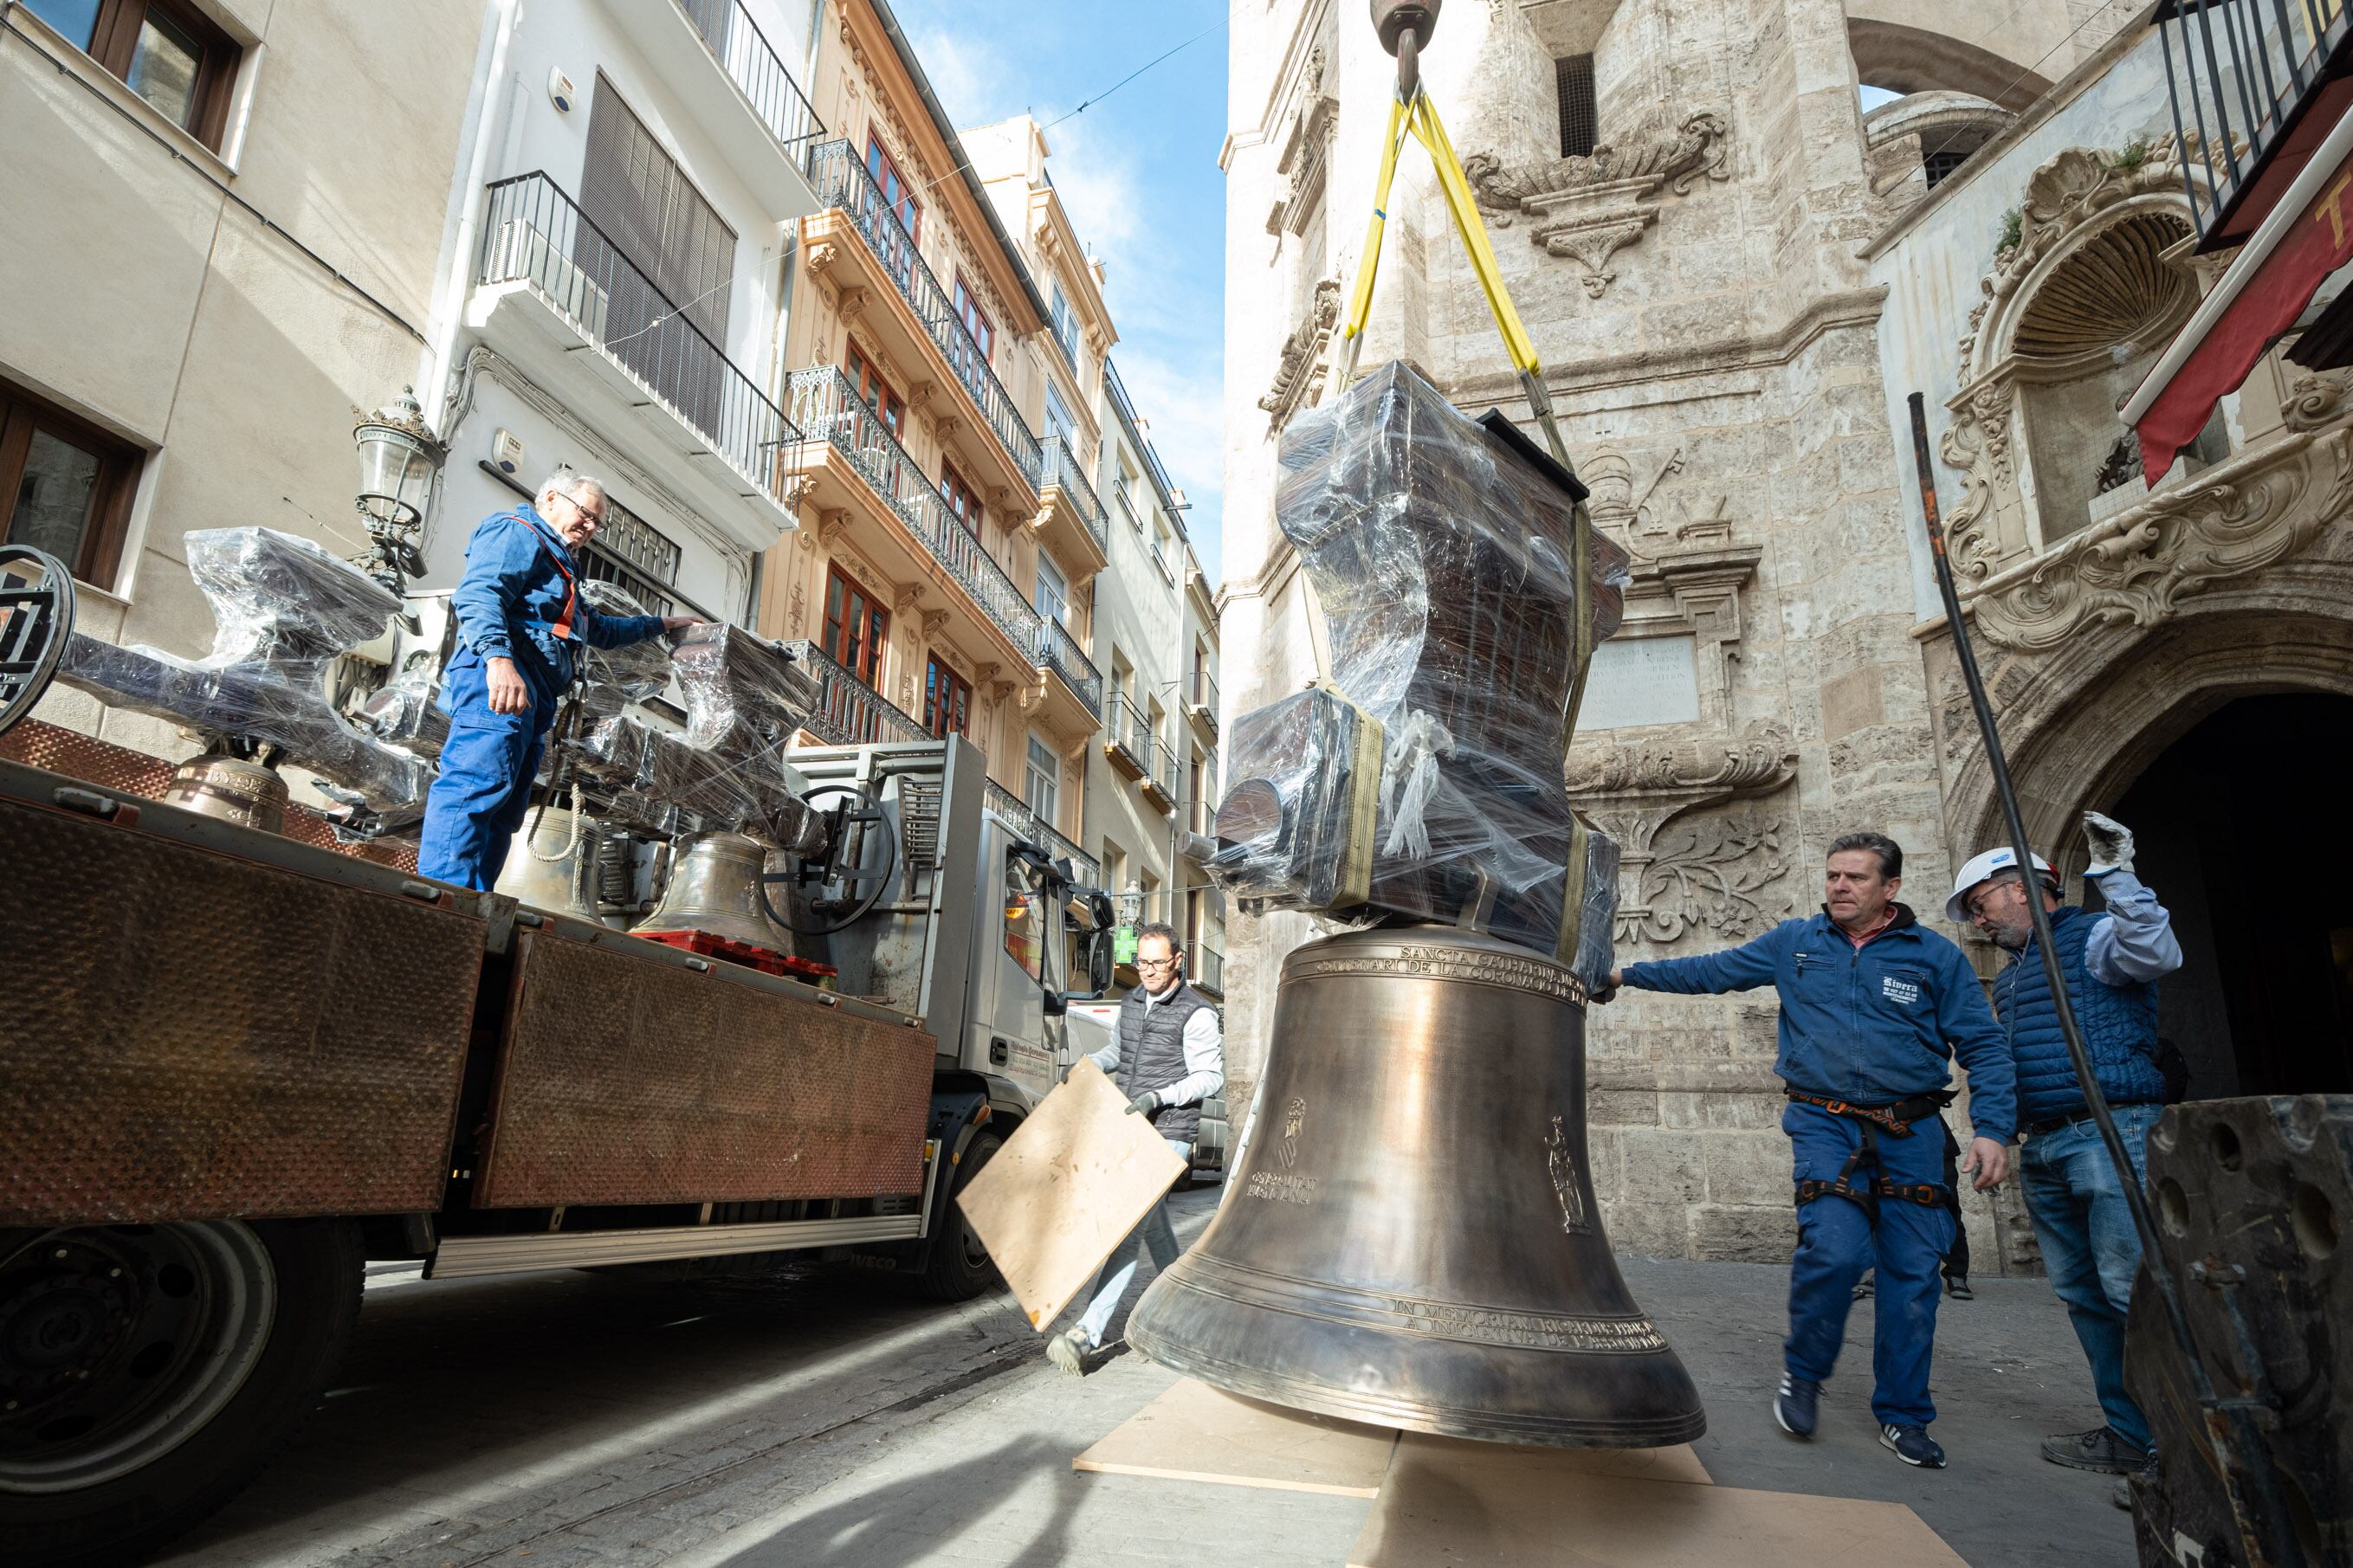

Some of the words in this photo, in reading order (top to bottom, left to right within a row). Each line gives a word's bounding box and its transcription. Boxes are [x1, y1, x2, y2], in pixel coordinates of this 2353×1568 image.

[1400, 946, 1470, 965] SANCTA
[1406, 960, 1431, 973] DE
[1439, 963, 1461, 977] LA
[850, 1254, 897, 1269] IVECO
[1393, 1300, 1416, 1315] IN
[1425, 1306, 1533, 1331] MEMORIAM
[1406, 1316, 1420, 1331] A
[1430, 1320, 1536, 1345] INICIATIVA
